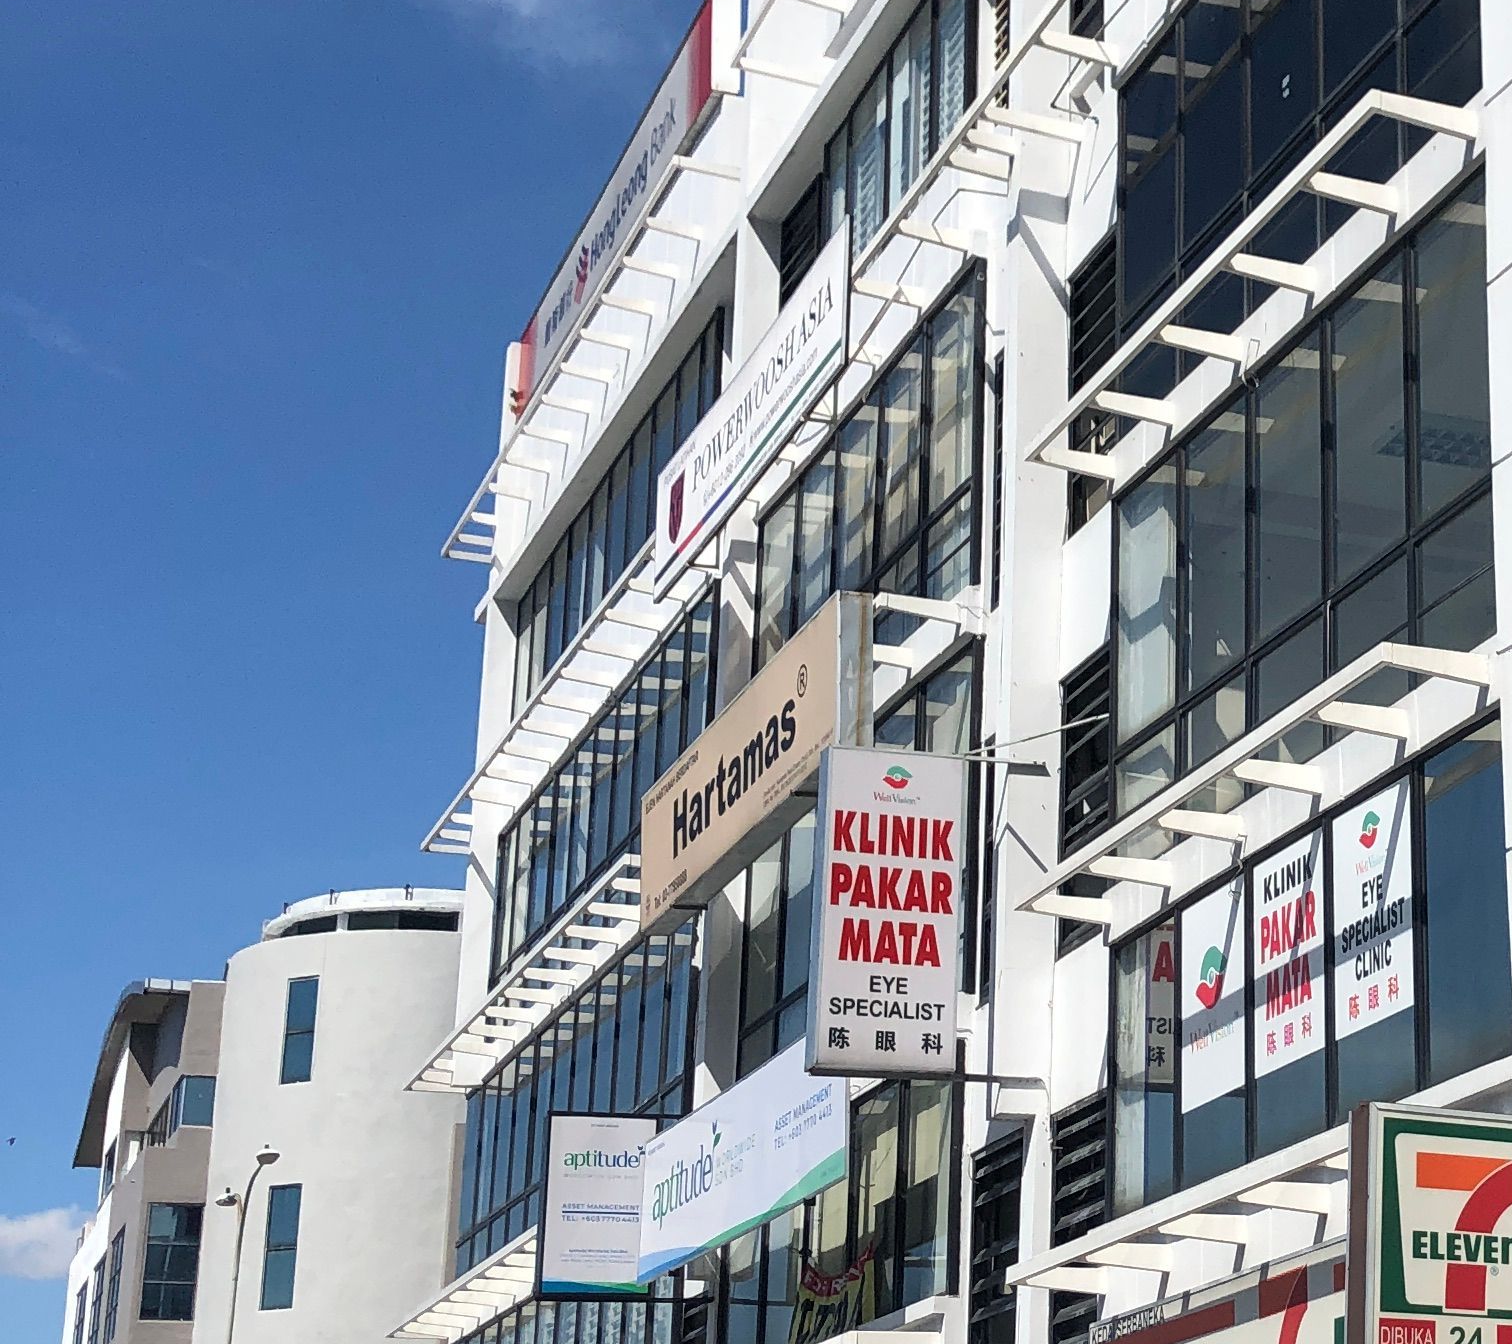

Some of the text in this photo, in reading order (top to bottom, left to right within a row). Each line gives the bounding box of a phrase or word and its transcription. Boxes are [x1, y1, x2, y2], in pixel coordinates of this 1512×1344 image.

[691, 323, 796, 494] POWERWOOSH
[797, 276, 834, 355] ASIA
[673, 698, 797, 860] Hartamas
[833, 809, 954, 862] KLINIK
[830, 862, 953, 915] PAKAR
[1263, 852, 1313, 904] KLINIK
[1361, 874, 1384, 909] EYE
[838, 917, 941, 968] MATA
[1260, 890, 1317, 965] PAKAR
[1341, 897, 1406, 954] SPECIALIST
[869, 974, 909, 995] EYE
[1355, 939, 1392, 981] CLINIC
[829, 997, 945, 1022] SPECIALIST
[1265, 953, 1312, 1021] MATA
[774, 1083, 832, 1132] ASSET MANAGEMENT
[563, 1149, 640, 1171] aptitude
[586, 1203, 640, 1212] MANAGEMENT
[652, 1144, 713, 1231] aptitude
[1115, 1305, 1165, 1340] SERBANEKA
